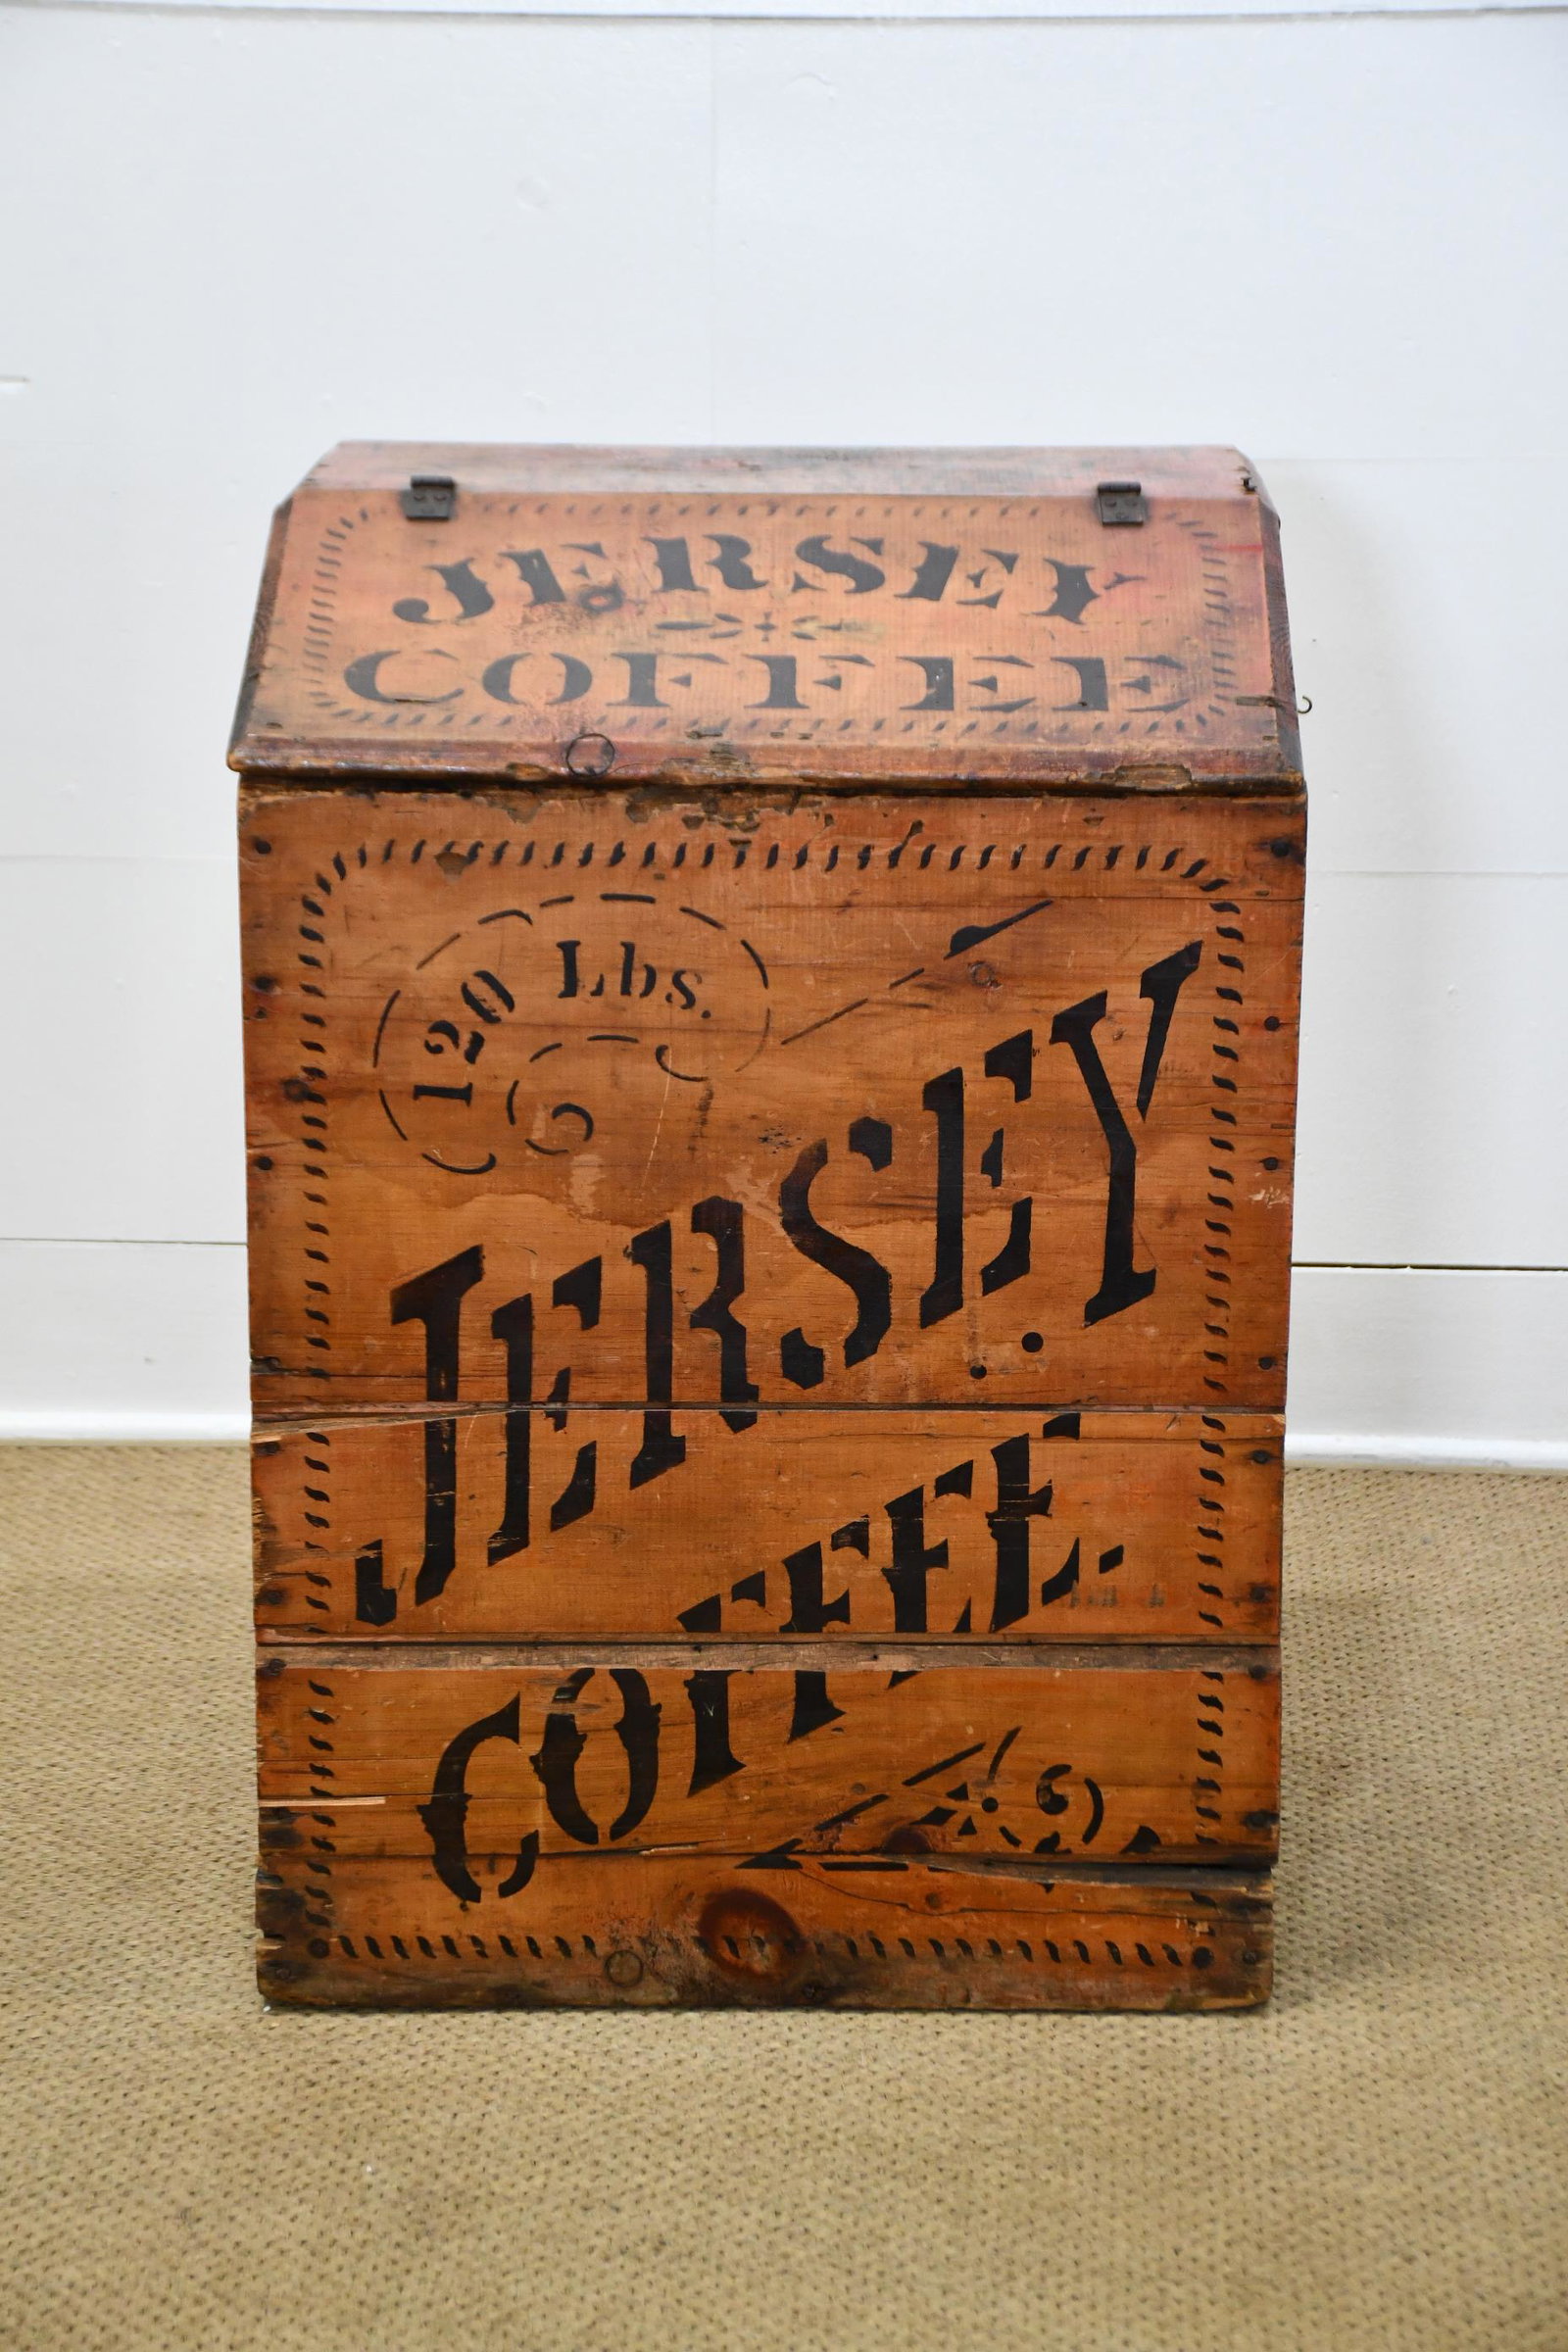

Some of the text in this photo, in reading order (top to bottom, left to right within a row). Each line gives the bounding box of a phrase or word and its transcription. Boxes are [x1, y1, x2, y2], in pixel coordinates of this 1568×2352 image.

[393, 535, 1148, 624] JERSEY
[344, 649, 1189, 712] COFFEE
[414, 970, 515, 1107] 120
[356, 939, 1203, 1627] JERSEY
